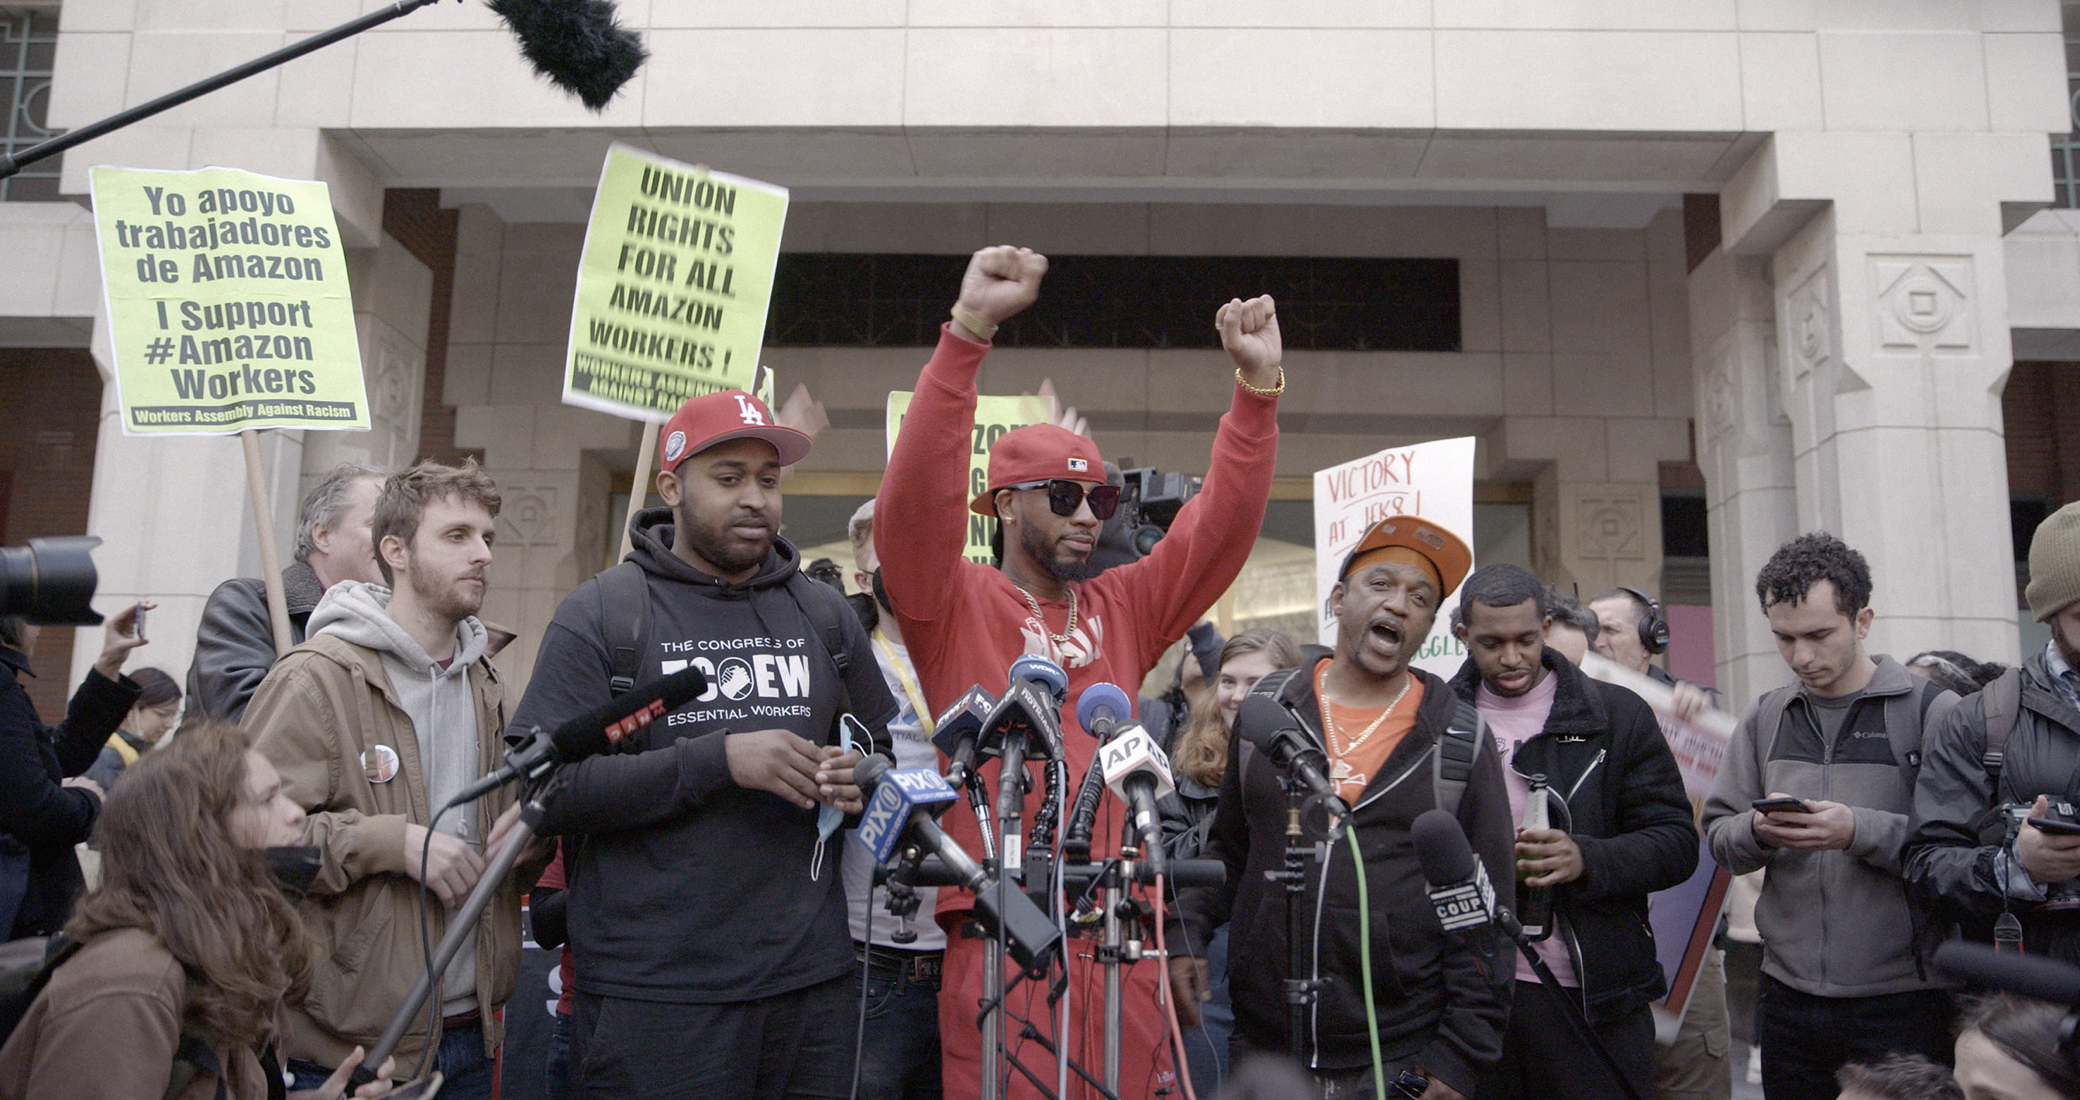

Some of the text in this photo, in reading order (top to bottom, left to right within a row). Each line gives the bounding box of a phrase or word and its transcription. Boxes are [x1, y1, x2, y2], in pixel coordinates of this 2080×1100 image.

[143, 186, 295, 217] Yo apoyo
[640, 167, 736, 216] UNION
[115, 217, 331, 250] trabajadores
[627, 202, 735, 257] RIGHTS
[136, 253, 323, 283] de Amazon
[617, 243, 735, 298] FOR ALL
[156, 300, 313, 330] I Support
[609, 283, 723, 332] AMAZON
[144, 335, 313, 365] #Amazon
[589, 318, 715, 372] WORKERS
[170, 364, 316, 400] Workers
[135, 404, 350, 423] Workers Assembly Against Racism
[734, 395, 765, 426] LA
[1328, 451, 1415, 503] VICTORY
[1328, 518, 1349, 547] AT
[661, 638, 806, 653] THE CONGRESS OF
[667, 705, 812, 727] ESSENTIAL WORKERS
[1107, 737, 1141, 771] AP
[1436, 898, 1480, 918] COUP
